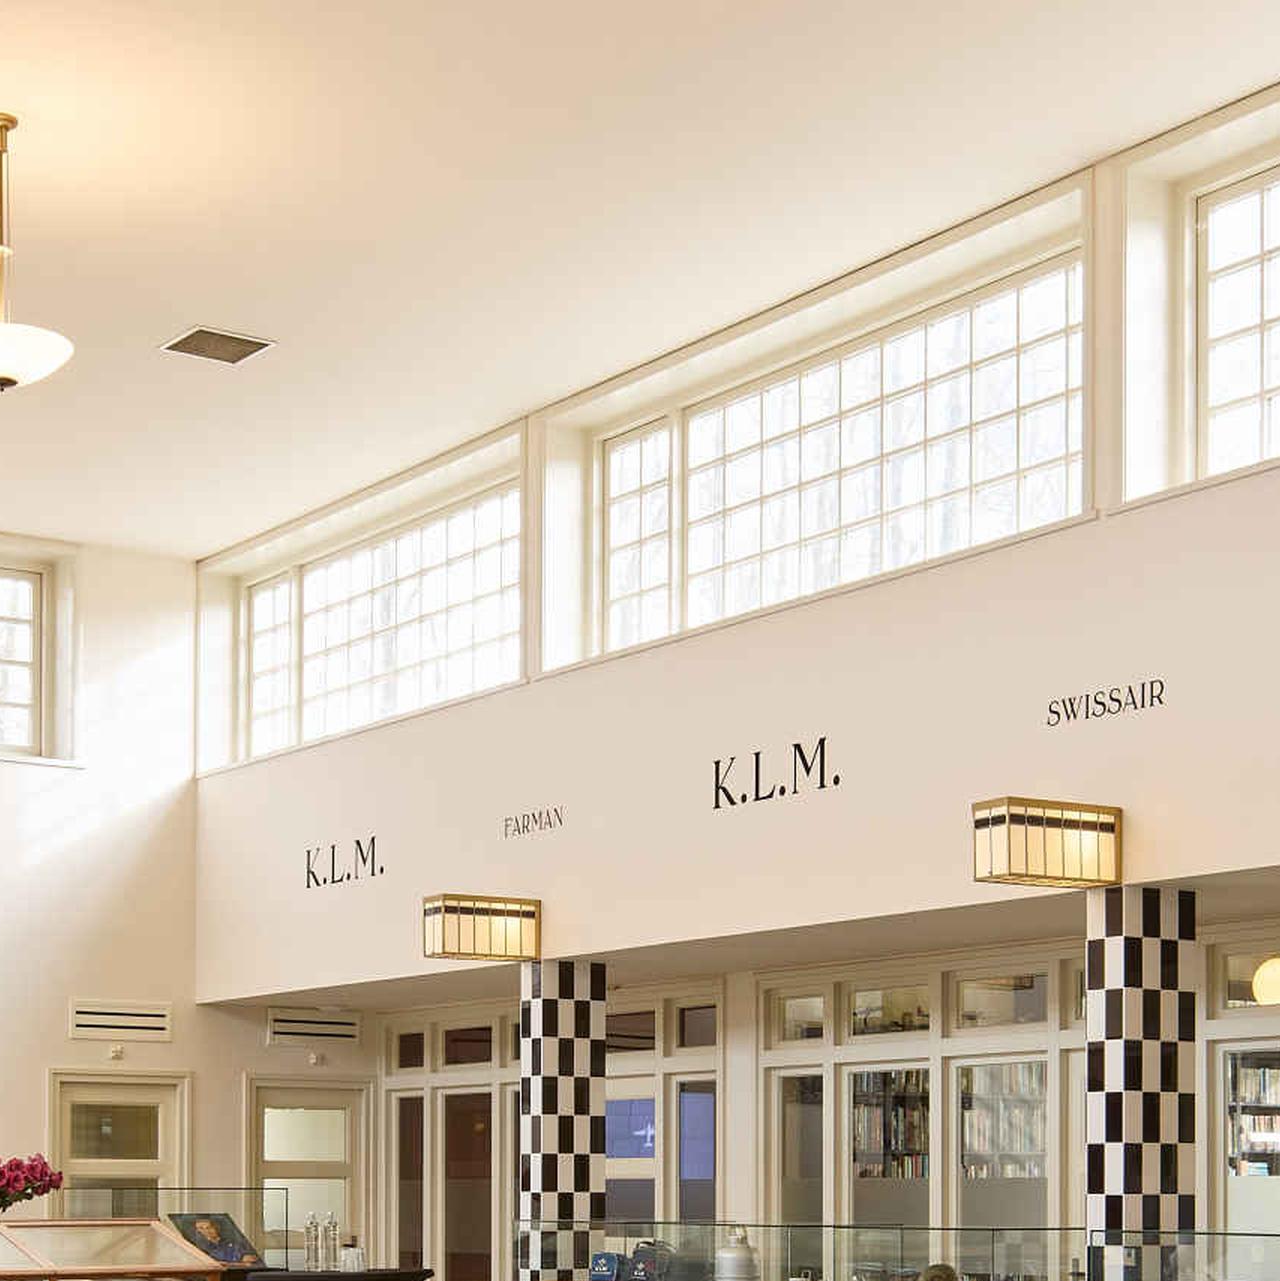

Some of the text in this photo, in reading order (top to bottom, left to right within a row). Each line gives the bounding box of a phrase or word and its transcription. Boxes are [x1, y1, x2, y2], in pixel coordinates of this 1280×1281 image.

[1047, 679, 1166, 726] SWISSAIR
[713, 736, 840, 812] K.L.M.
[505, 806, 562, 839] FARMAN
[306, 836, 384, 888] K.L.M.
